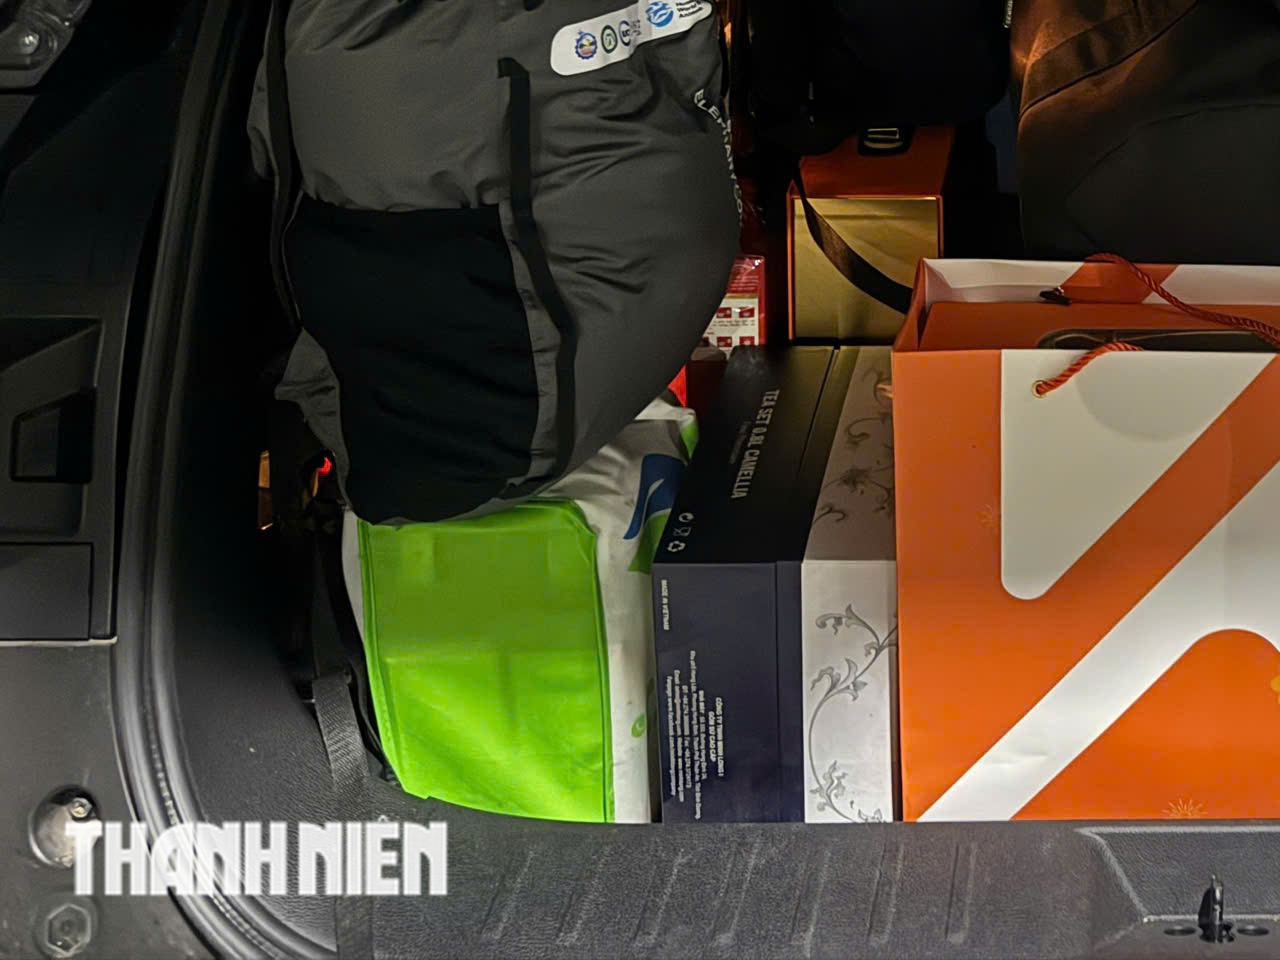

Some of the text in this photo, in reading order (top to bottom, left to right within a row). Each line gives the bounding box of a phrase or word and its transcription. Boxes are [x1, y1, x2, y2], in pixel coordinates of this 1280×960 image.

[762, 389, 780, 407] TEA
[755, 408, 774, 424] SET
[730, 449, 761, 498] CAMELLIA
